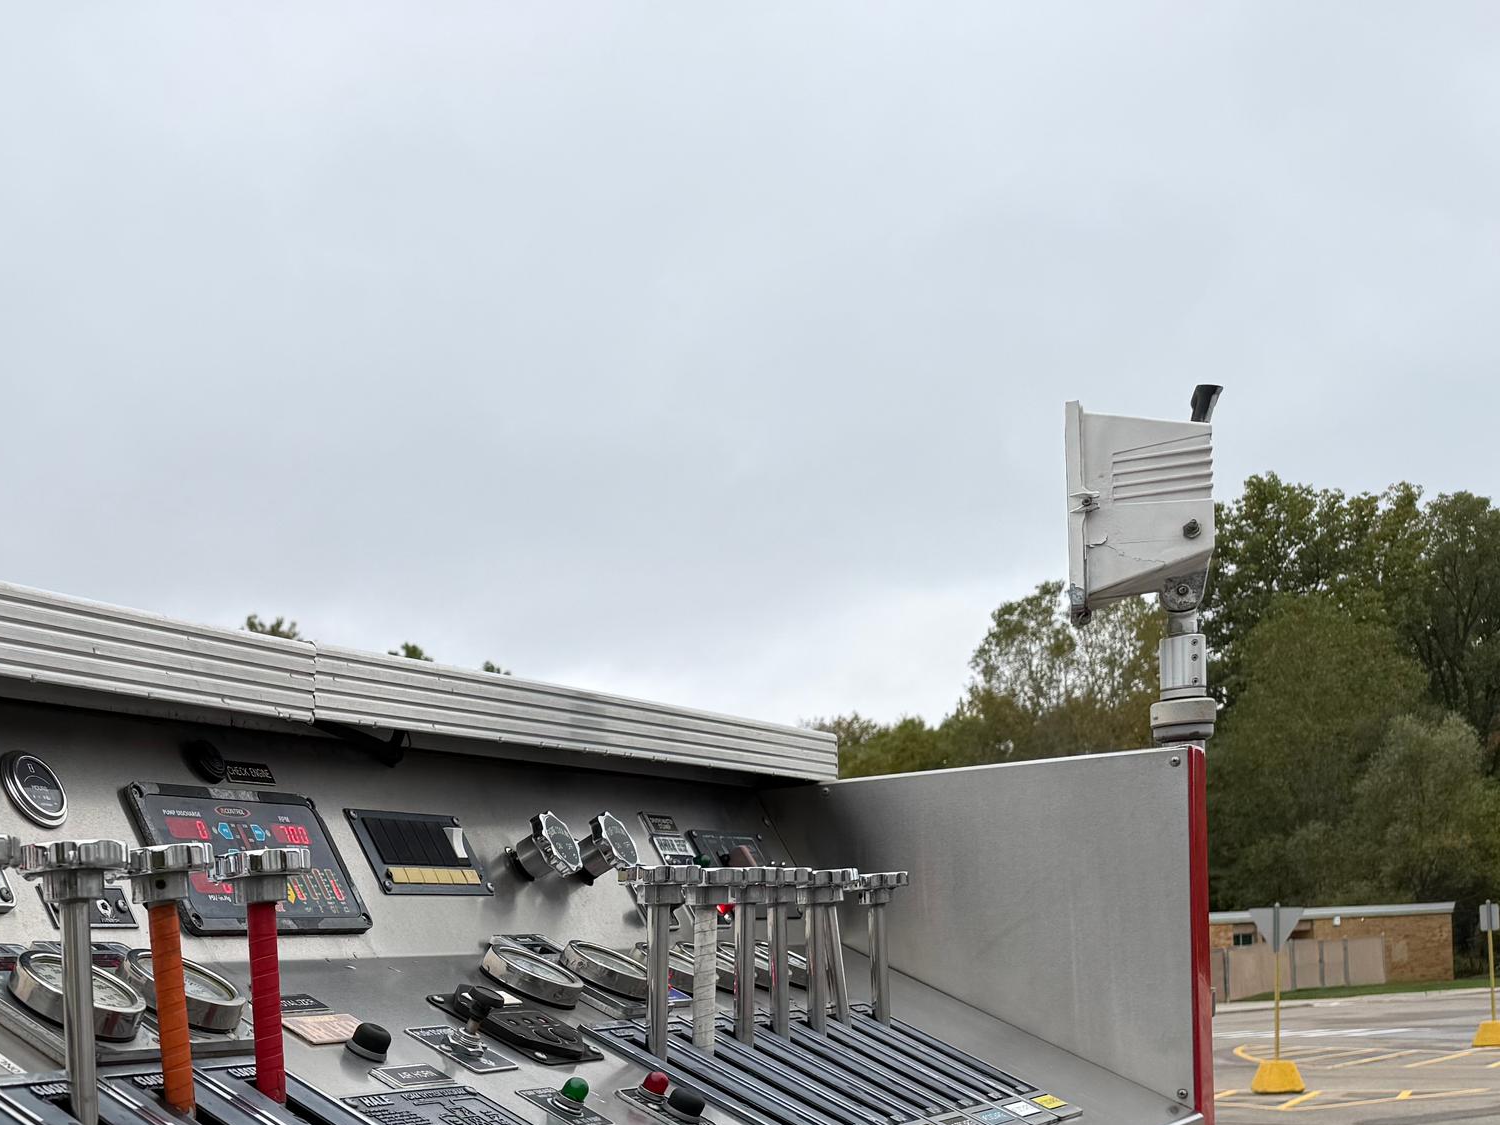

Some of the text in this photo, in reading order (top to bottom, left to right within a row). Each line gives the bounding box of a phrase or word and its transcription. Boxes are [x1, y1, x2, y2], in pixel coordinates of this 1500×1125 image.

[227, 765, 272, 779] CHECK ENGINE
[279, 825, 310, 845] 700
[32, 1083, 70, 1096] CLOSE
[359, 1094, 392, 1106] HALE
